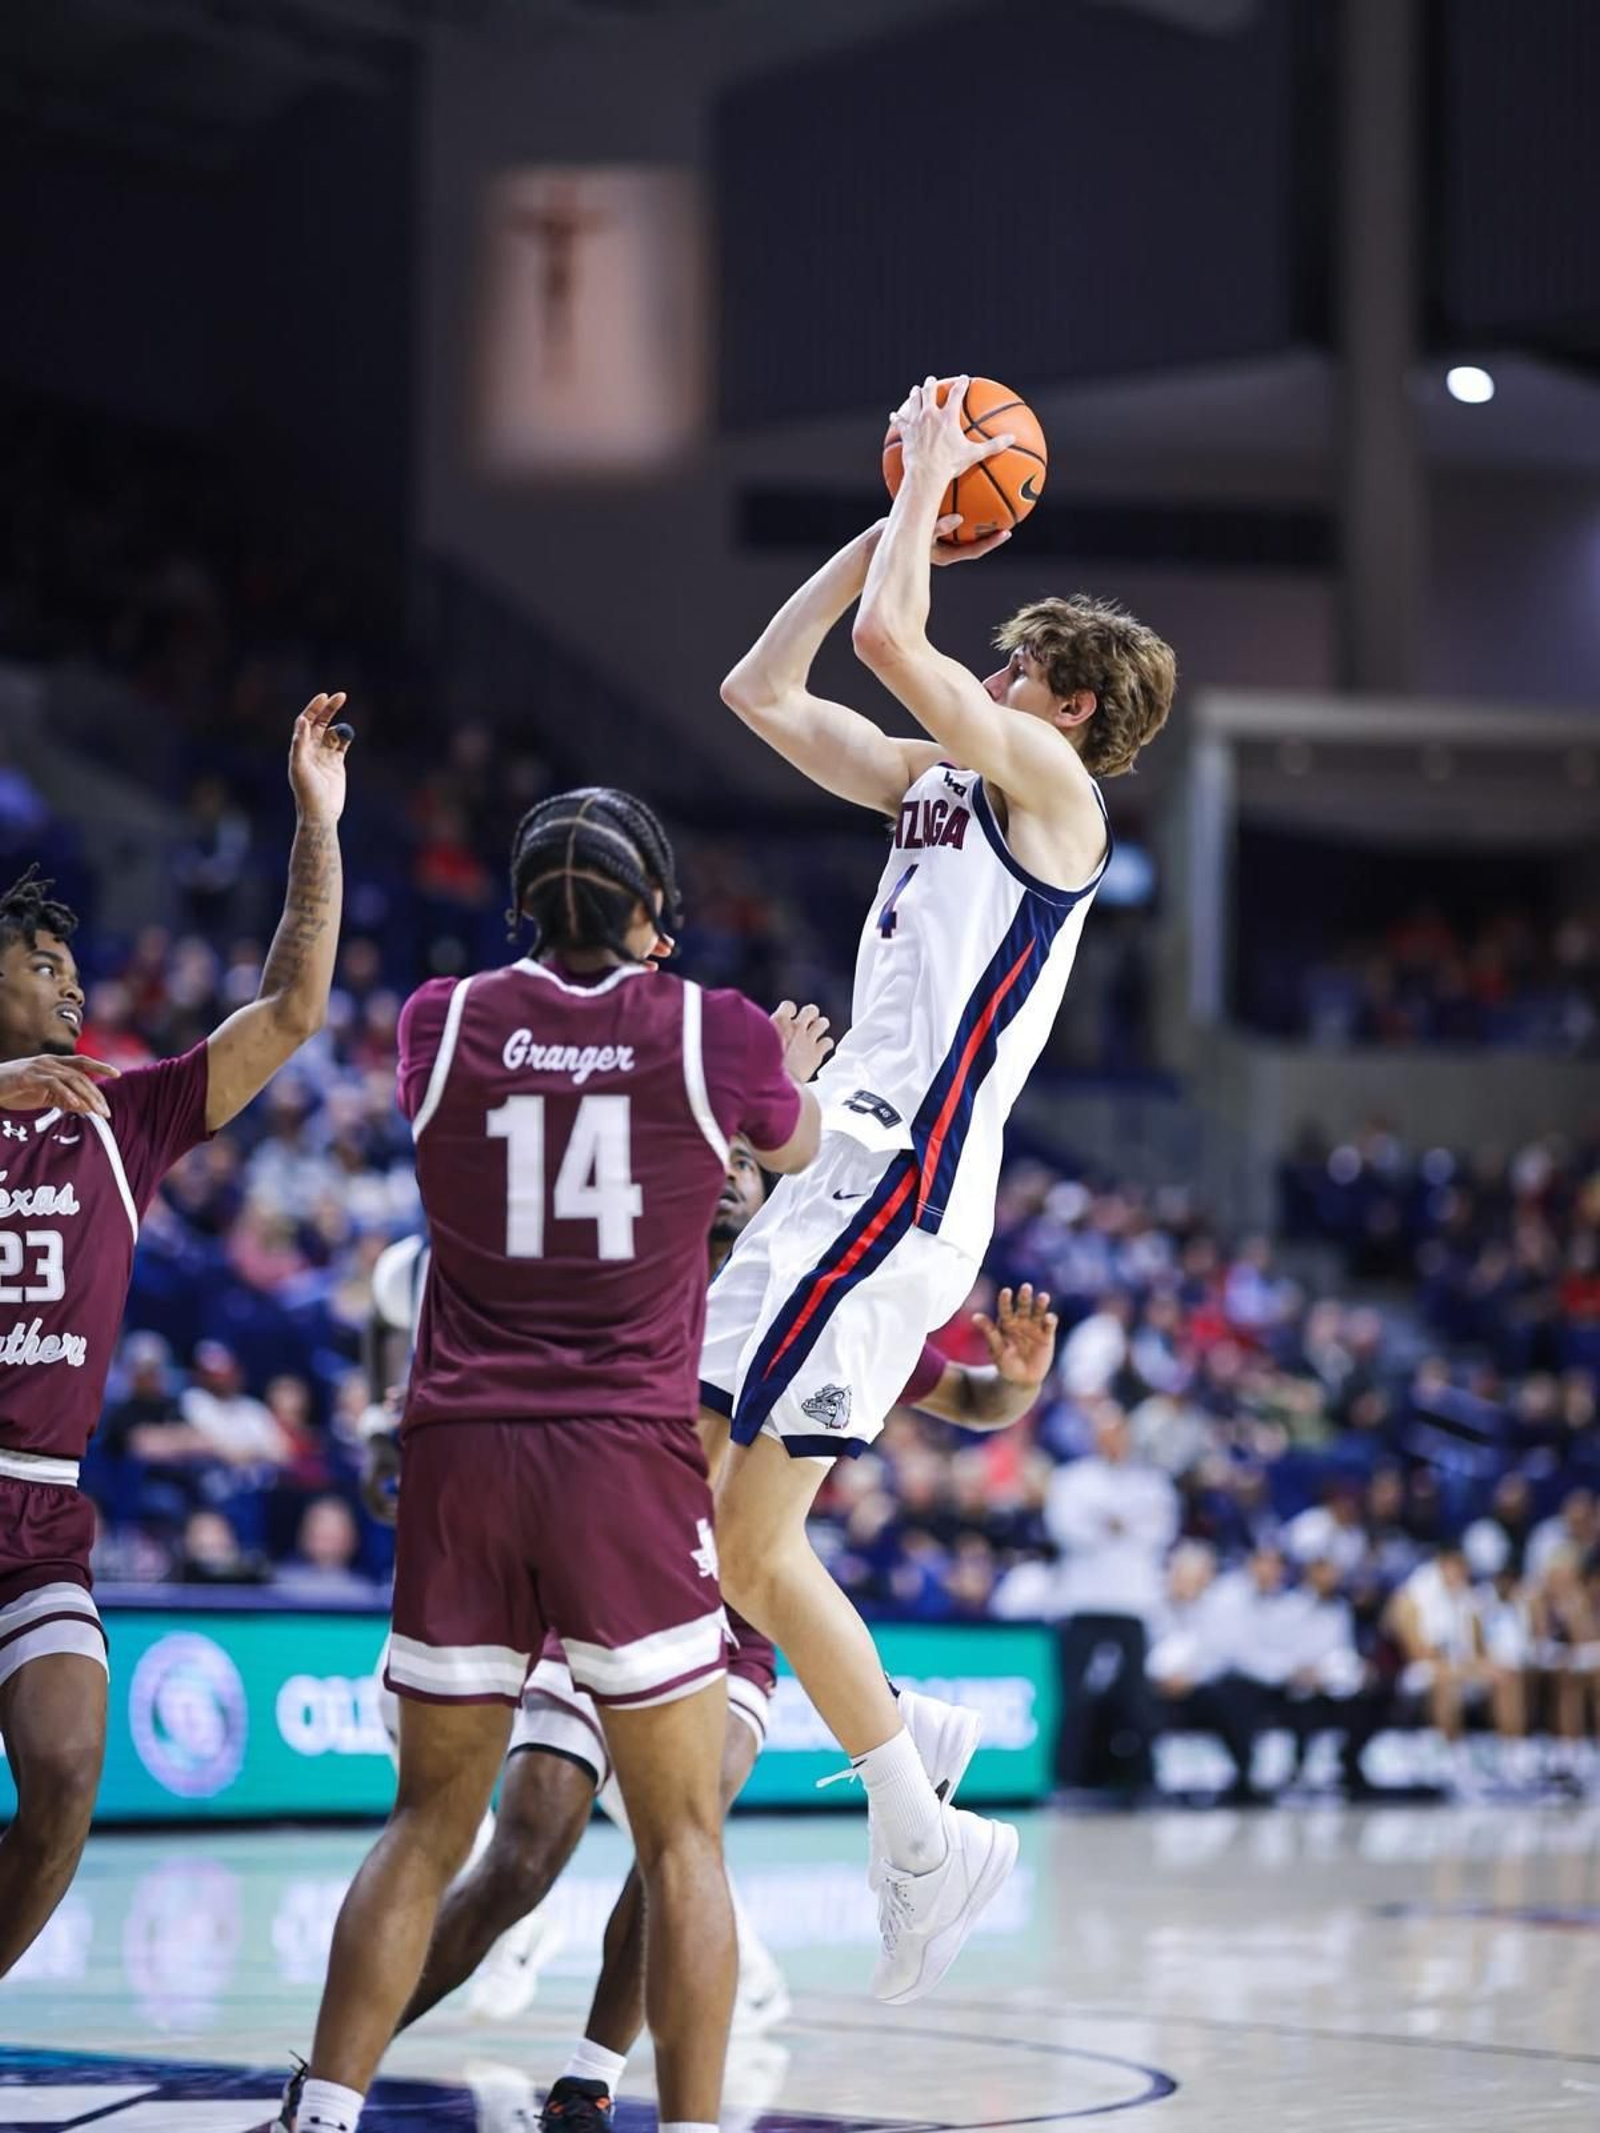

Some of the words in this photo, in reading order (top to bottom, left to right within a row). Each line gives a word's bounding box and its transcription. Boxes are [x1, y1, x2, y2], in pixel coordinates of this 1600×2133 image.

[503, 1028, 635, 1085] Granger
[0, 1170, 80, 1217] exas
[486, 1095, 643, 1261] 14
[0, 1230, 65, 1303] 23
